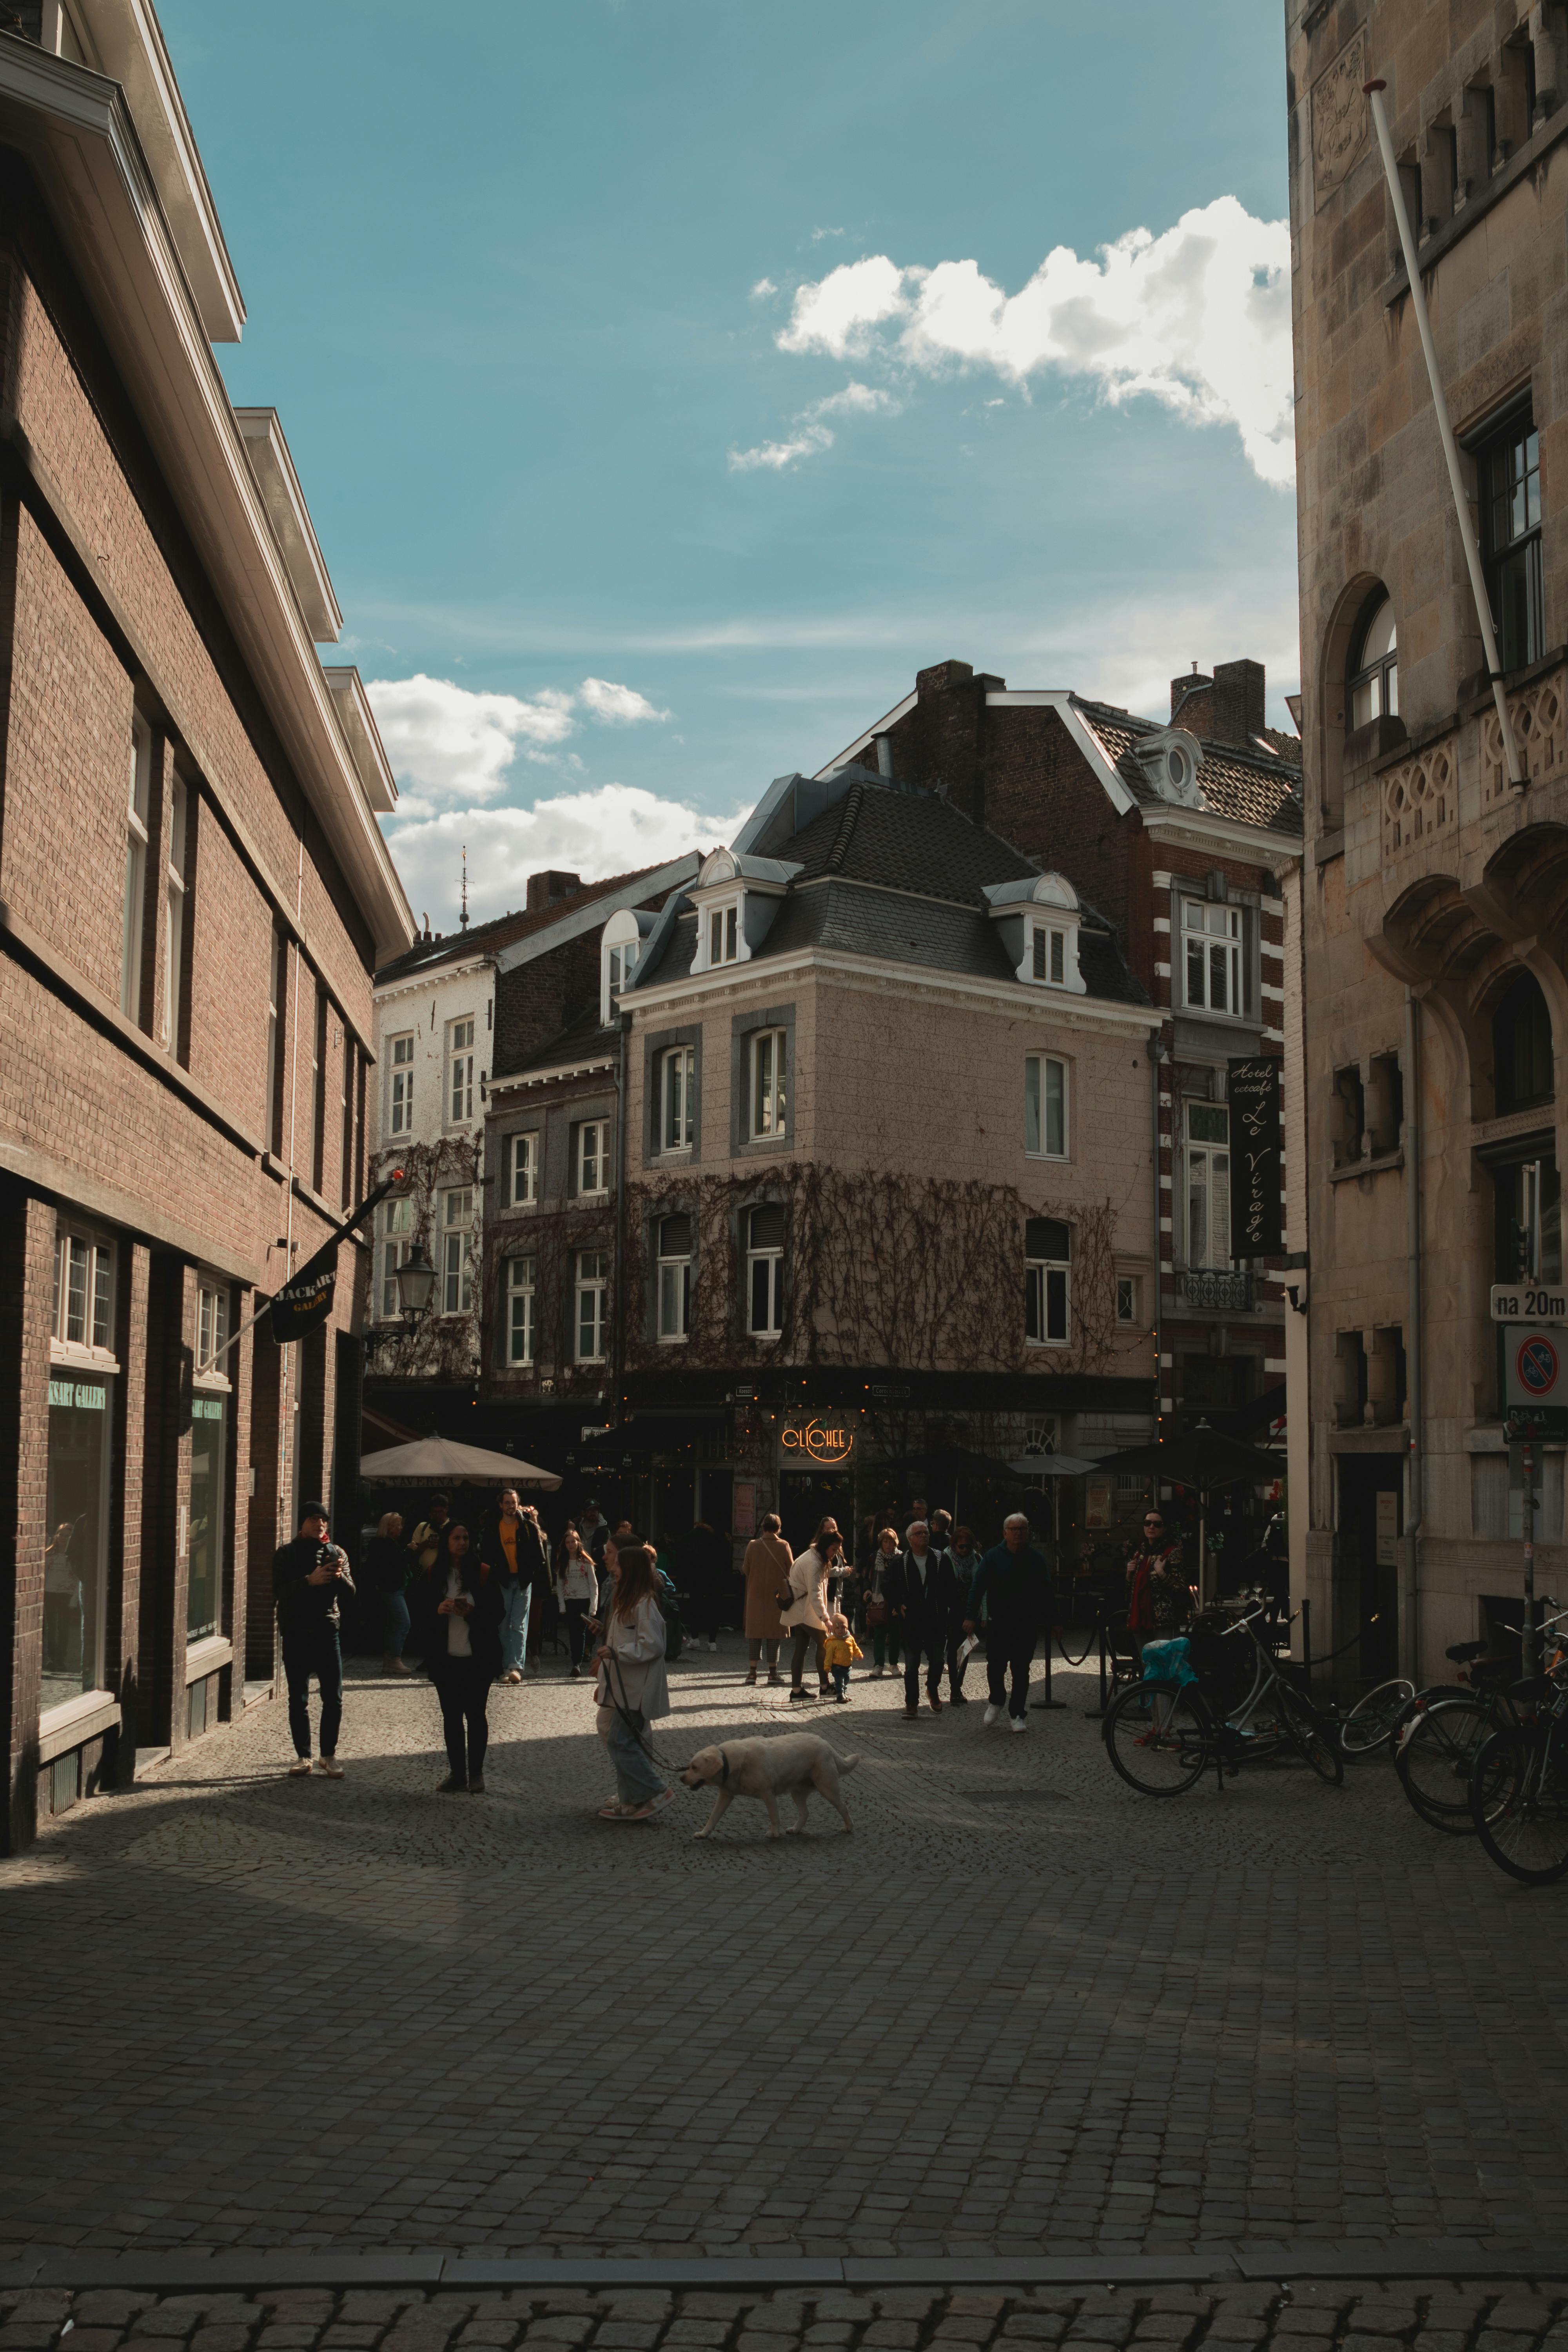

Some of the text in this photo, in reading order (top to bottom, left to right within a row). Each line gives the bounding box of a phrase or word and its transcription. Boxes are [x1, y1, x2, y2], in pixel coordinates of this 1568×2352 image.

[1231, 1063, 1273, 1078] Hotel
[1234, 1080, 1272, 1095] eetcafé
[1242, 1101, 1267, 1136] Le
[1245, 1148, 1271, 1241] Virage
[1498, 1291, 1565, 1315] na 20m
[76, 1384, 106, 1410] GALLERY
[390, 1477, 543, 1489] TAVERNA LA VACA
